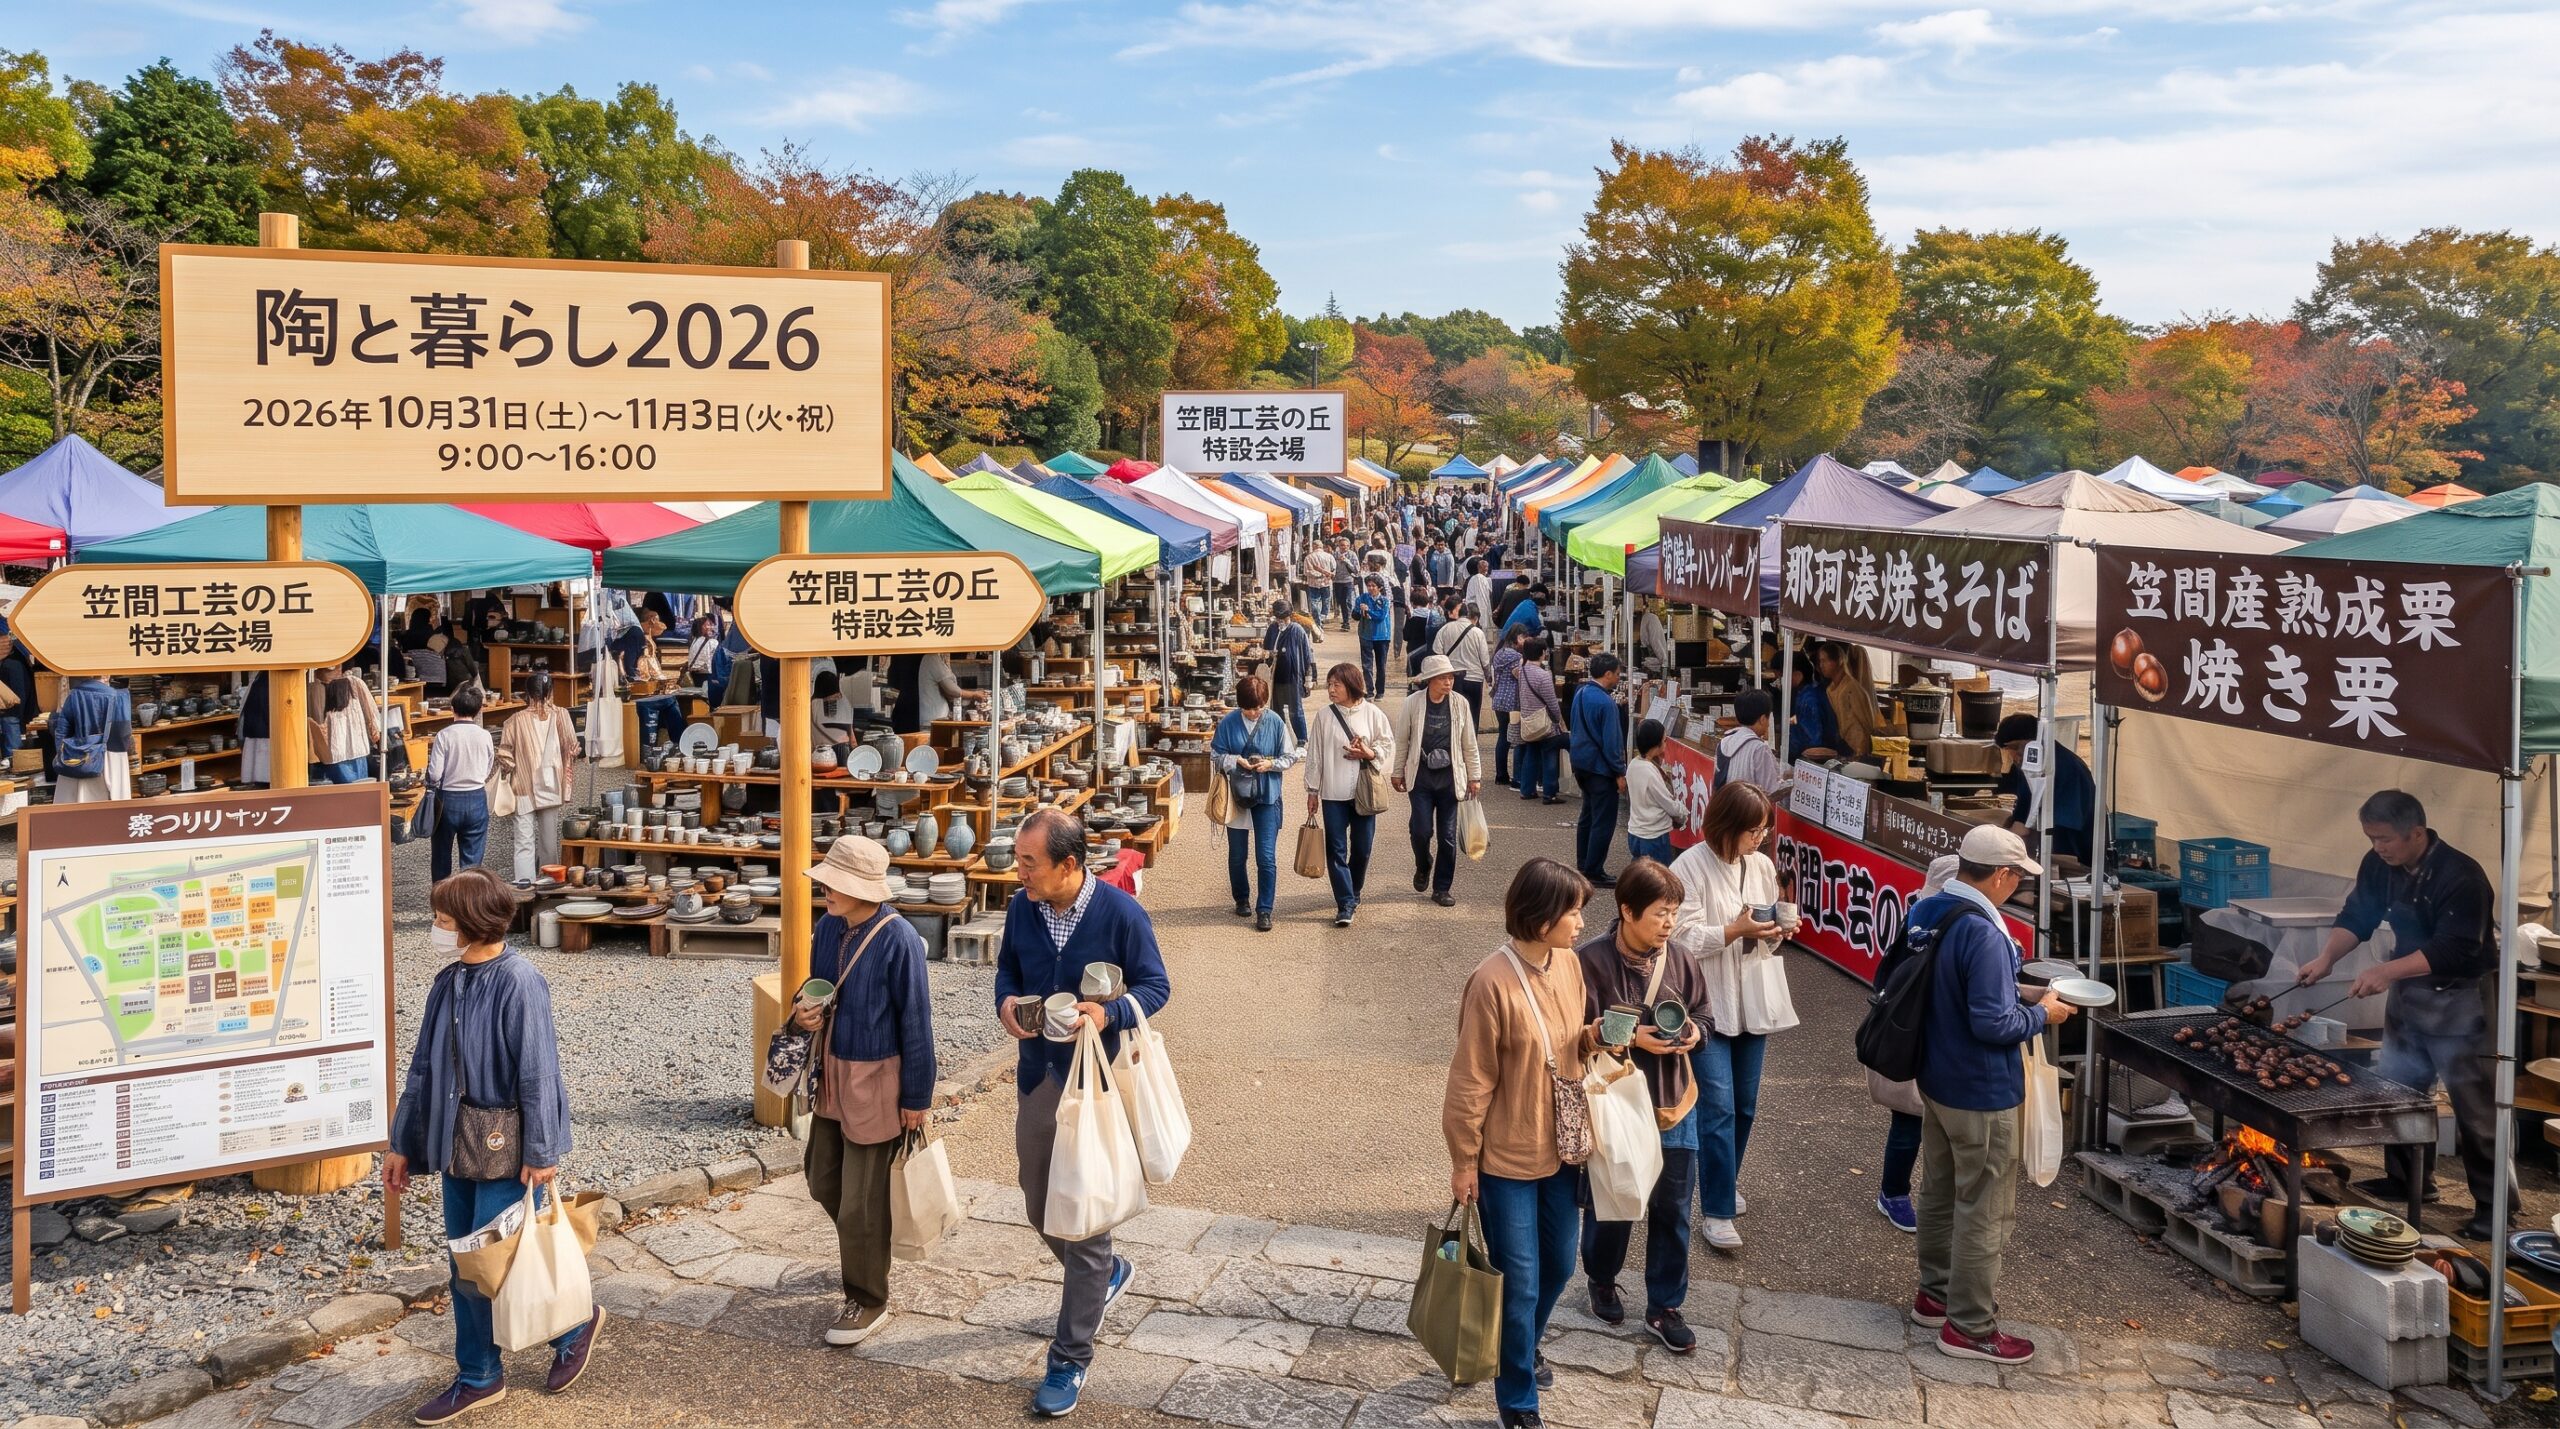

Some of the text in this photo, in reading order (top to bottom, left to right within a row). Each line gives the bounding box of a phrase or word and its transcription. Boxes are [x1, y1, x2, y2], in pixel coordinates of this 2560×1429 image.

[257, 287, 820, 372] 陶と暮らし2026
[1176, 404, 1331, 432] 笠間工芸の丘
[1202, 435, 1306, 462] 特設会場
[82, 582, 315, 620] 笠間工芸の丘
[787, 567, 1000, 606] 笠間工芸の丘
[1785, 543, 2039, 643] 那珂湊焼きそば
[831, 607, 955, 641] 特設会場
[2125, 561, 2462, 651] 笠間産熟成栗
[128, 620, 274, 657] 特設会場
[2181, 638, 2407, 740] 焼き栗
